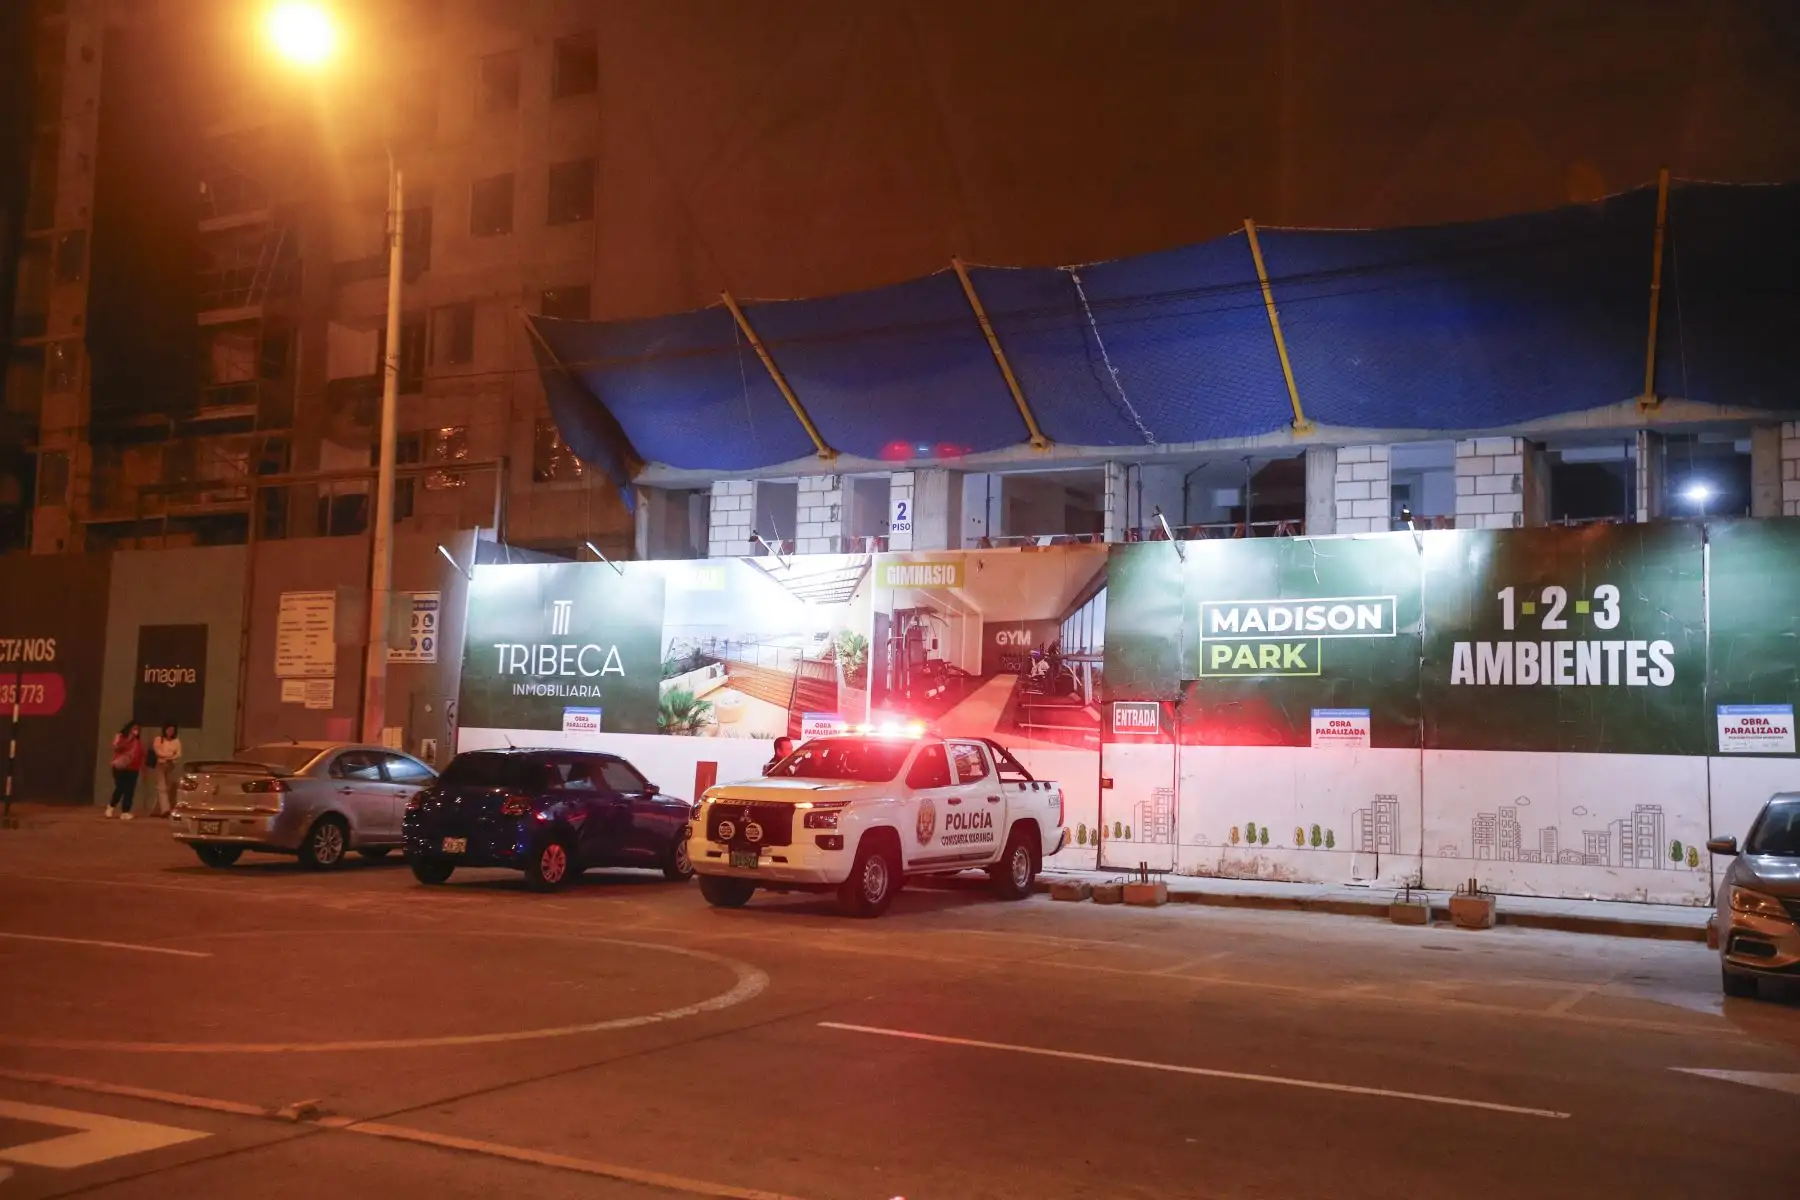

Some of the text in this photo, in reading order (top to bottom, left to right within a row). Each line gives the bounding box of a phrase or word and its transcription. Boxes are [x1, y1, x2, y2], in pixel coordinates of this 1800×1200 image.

[896, 502, 907, 520] 2
[892, 523, 911, 531] PISO
[887, 564, 956, 585] GIMNASIO
[1211, 604, 1382, 633] MADISON
[995, 630, 1032, 646] GYM
[493, 643, 625, 677] TRIBECA
[1211, 643, 1307, 669] PARK
[1450, 640, 1675, 687] AMBIENTES
[144, 665, 196, 687] imagina
[513, 683, 601, 698] INMOBILIARIA
[1115, 709, 1156, 727] ENTRADA
[945, 809, 992, 830] POLICÍA
